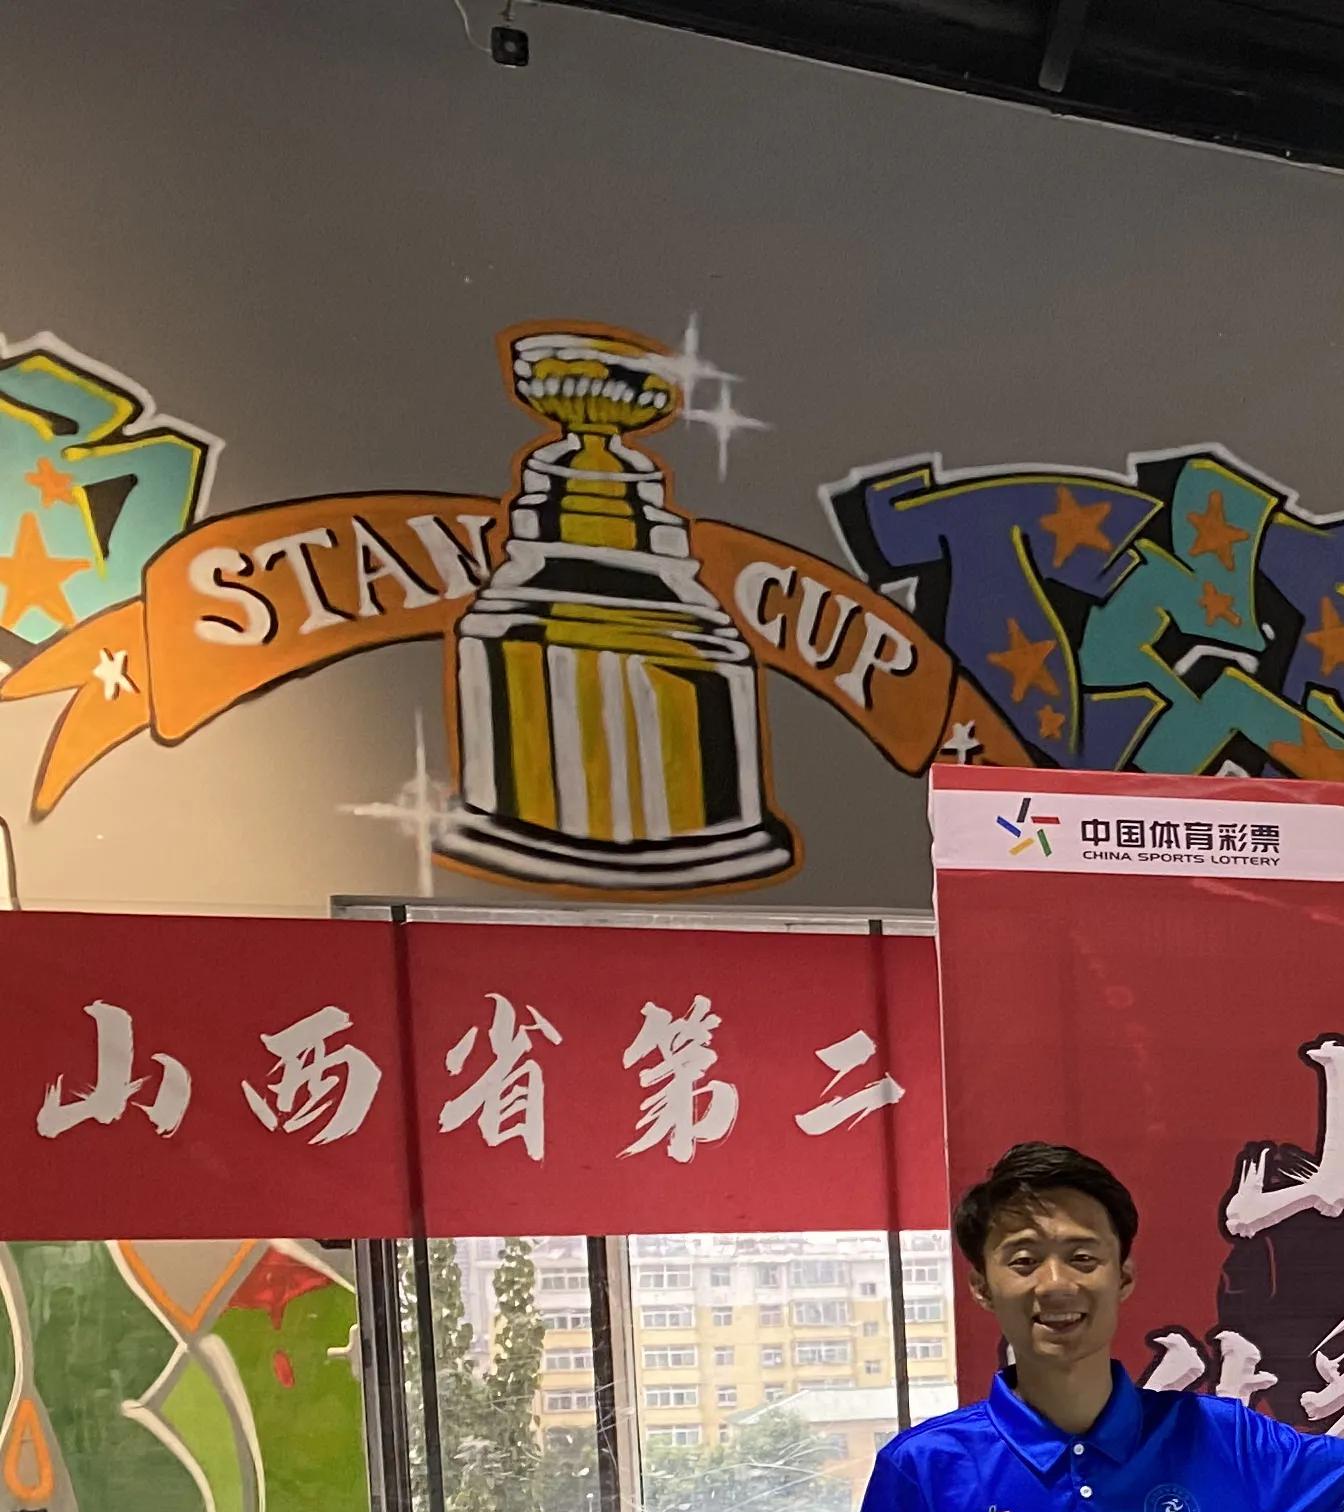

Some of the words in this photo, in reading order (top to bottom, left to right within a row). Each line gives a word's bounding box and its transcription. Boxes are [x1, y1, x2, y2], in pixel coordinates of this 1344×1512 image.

[733, 560, 919, 710] CUP
[1081, 818, 1281, 854] 中国体育彩票
[1082, 850, 1133, 862] CHINA
[1137, 852, 1206, 864] SPORTS
[1210, 854, 1281, 867] LOTTERY
[36, 993, 906, 1165] 山西省第二
